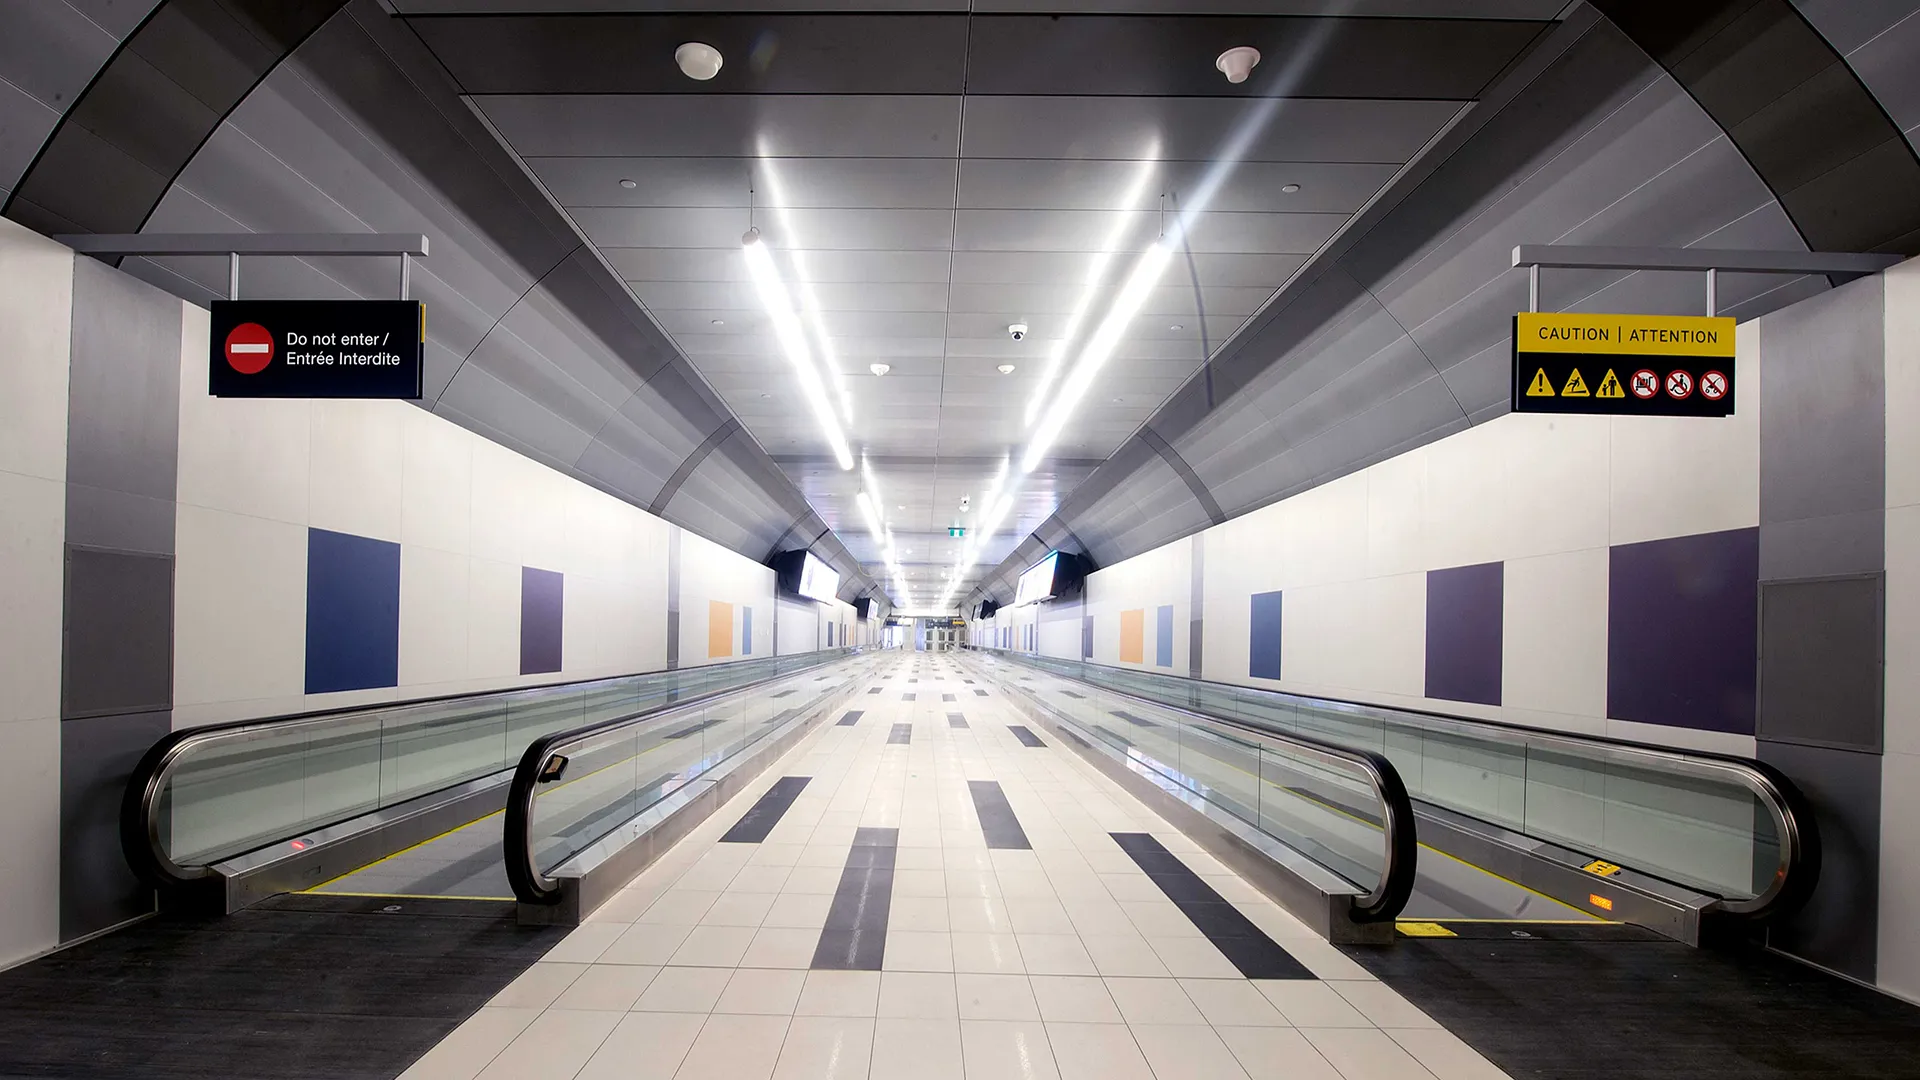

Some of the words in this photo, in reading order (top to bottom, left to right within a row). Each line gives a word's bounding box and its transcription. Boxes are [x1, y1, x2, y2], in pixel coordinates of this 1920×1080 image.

[287, 332, 308, 346] Do
[312, 332, 337, 346] not
[340, 332, 380, 346] enter
[1538, 326, 1609, 341] CAUTION
[1629, 328, 1718, 344] ATTENTION
[286, 350, 335, 366] Entrée
[339, 351, 401, 366] Interdite
